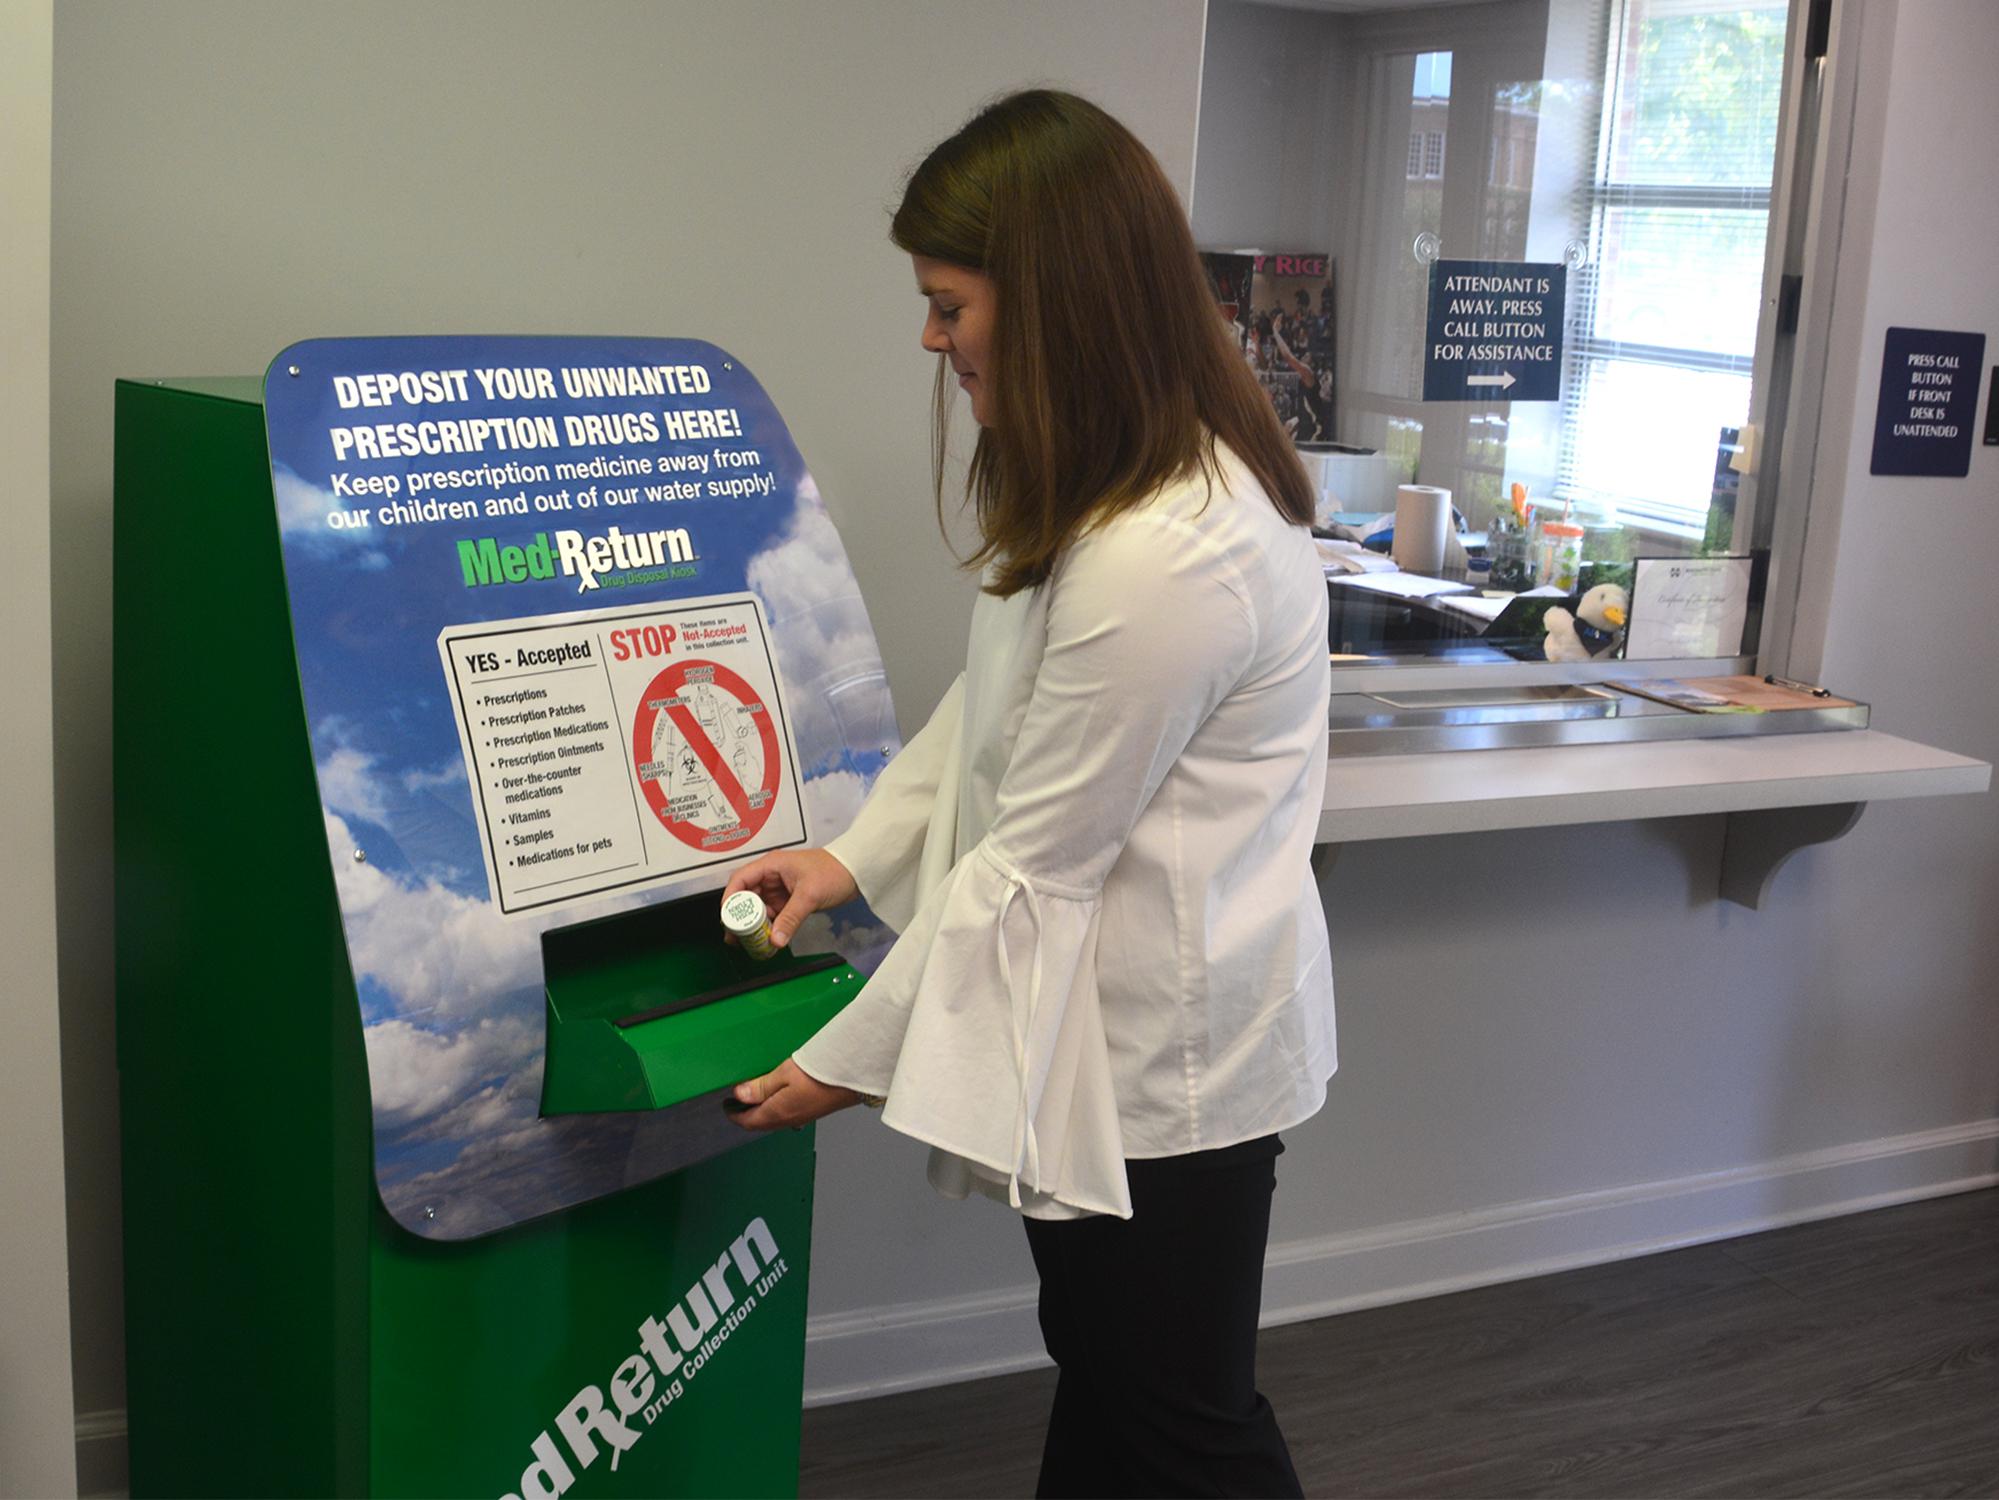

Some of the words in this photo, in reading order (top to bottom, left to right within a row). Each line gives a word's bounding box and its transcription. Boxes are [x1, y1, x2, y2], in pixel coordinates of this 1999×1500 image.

[1276, 255, 1325, 274] RICE
[1444, 276, 1533, 293] ATTENDANT
[1537, 279, 1550, 294] IS
[1449, 299, 1498, 315] AWAY.
[1502, 300, 1542, 316] PRESS
[1444, 321, 1479, 337] CALL
[1483, 322, 1545, 338] BUTTON
[1434, 344, 1463, 360] FOR
[1467, 345, 1553, 360] ASSISTANCE
[1908, 354, 1935, 366] PRESS
[1936, 355, 1960, 368] CALL
[333, 369, 469, 409] DEPOSIT
[474, 367, 558, 401] YOUR
[561, 365, 711, 399] UNWANTED
[1911, 372, 1953, 385] BUTTON
[1907, 389, 1918, 401] IF
[1918, 389, 1952, 403] FRONT
[1910, 407, 1934, 419] DESK
[1936, 408, 1945, 420] IS
[330, 416, 560, 461] PRESCRIPTION
[564, 411, 660, 447] DRUGS
[664, 409, 743, 441] HERE!
[1893, 424, 1958, 438] UNATTENDED
[331, 473, 400, 498] Keep
[406, 461, 550, 496] prescription
[555, 455, 653, 480] medicine
[657, 452, 709, 473] away
[713, 449, 760, 468] from
[327, 508, 370, 530] our
[378, 498, 479, 526] children
[485, 491, 529, 517] and
[535, 489, 573, 512] out
[577, 486, 599, 509] of
[604, 487, 639, 506] our
[645, 481, 702, 503] water
[708, 471, 777, 499] supply!
[601, 573, 625, 588] Drug
[626, 567, 670, 585] Disposal
[671, 565, 698, 578] Kiosk
[682, 624, 747, 641] Not-Accepted
[610, 624, 677, 661] STOP
[693, 642, 704, 650] this
[705, 638, 735, 648] collection
[465, 652, 500, 674] YES
[517, 640, 592, 667] Accepted
[484, 688, 548, 707] Prescriptions
[488, 709, 547, 728] Prescription
[549, 702, 586, 718] Patches
[493, 730, 551, 748] Prescription
[553, 719, 609, 738] Medications
[498, 750, 556, 769] Prescription
[557, 741, 605, 758] Ointments
[502, 765, 582, 789] Over-the-counter
[505, 784, 563, 804] medications
[508, 808, 551, 825] Vitamins
[513, 829, 554, 846] Samples
[517, 847, 575, 867] Medications
[576, 842, 590, 855] for
[593, 838, 613, 853] pets
[643, 1379, 684, 1425] Drug
[682, 1296, 757, 1380] Collection
[755, 1258, 789, 1297] Unit
